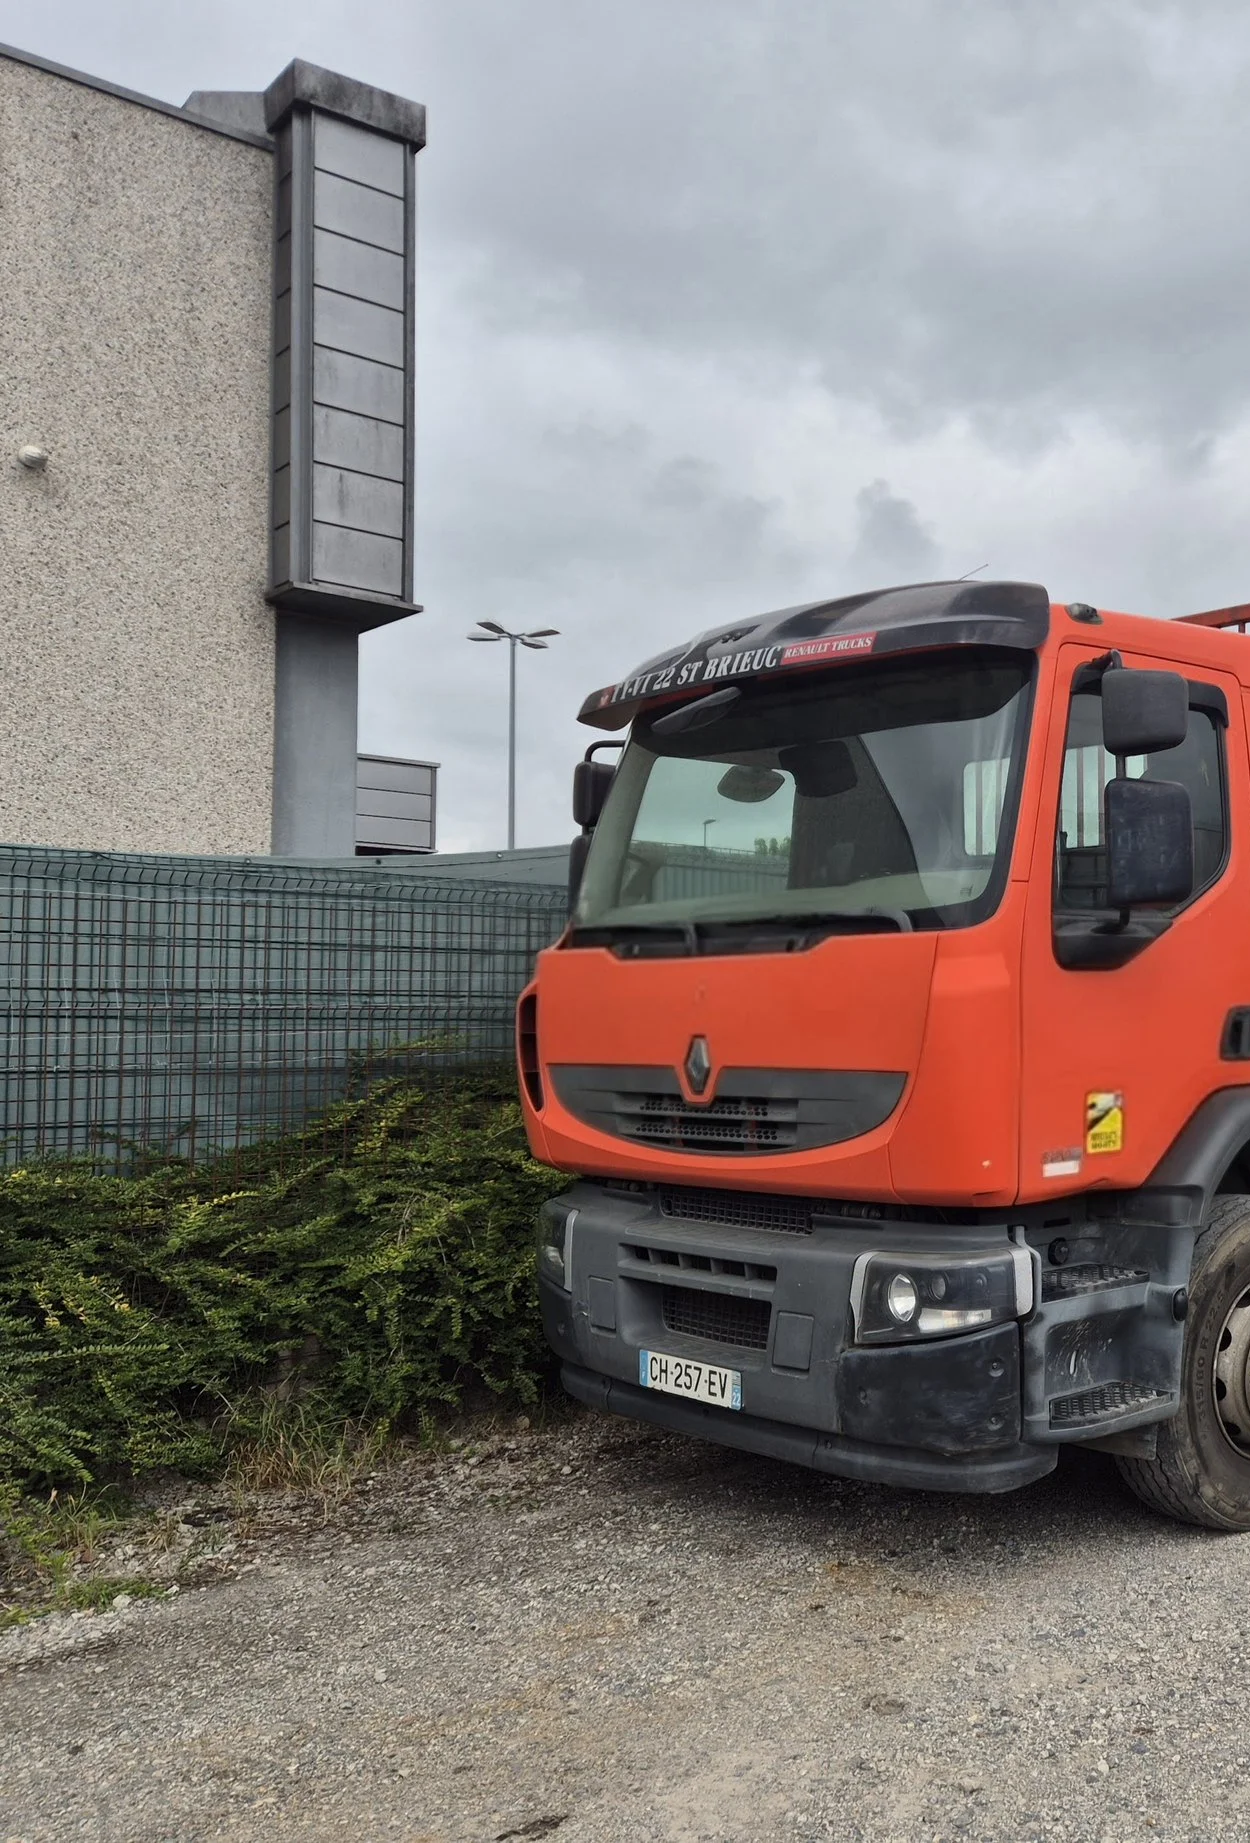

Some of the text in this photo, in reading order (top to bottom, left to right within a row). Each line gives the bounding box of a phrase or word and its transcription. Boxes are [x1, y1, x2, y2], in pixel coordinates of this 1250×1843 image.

[783, 636, 873, 659] RENAULT TRUCKS
[652, 667, 676, 691] 22
[676, 660, 704, 685] ST
[702, 645, 782, 681] BRIEUC
